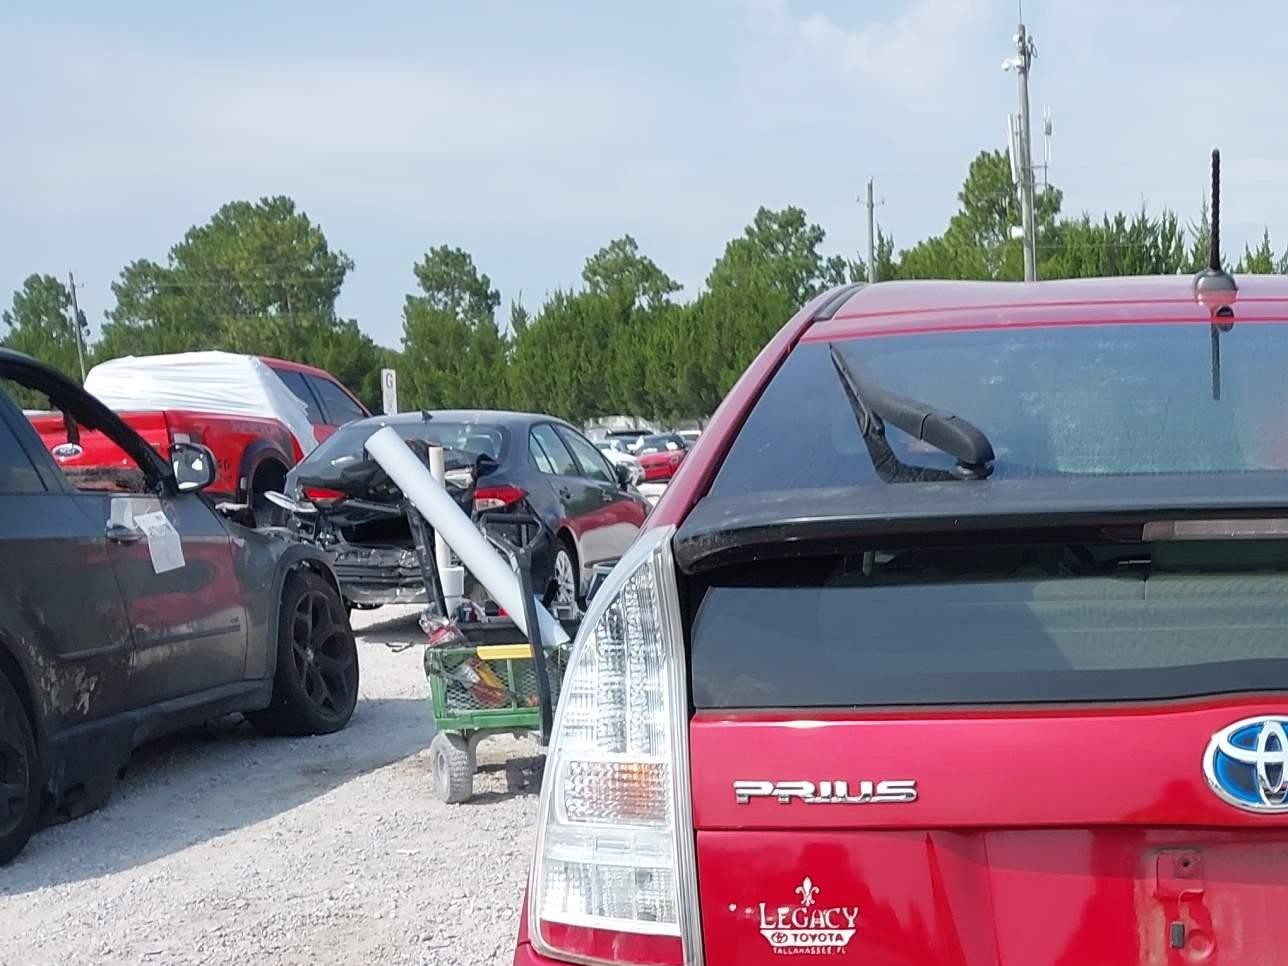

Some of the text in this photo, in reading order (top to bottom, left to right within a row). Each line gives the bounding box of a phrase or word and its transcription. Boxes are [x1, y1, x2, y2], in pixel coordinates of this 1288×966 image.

[733, 780, 917, 804] PRIUS
[759, 902, 859, 929] LEGACY
[791, 932, 844, 943] TOYOTA
